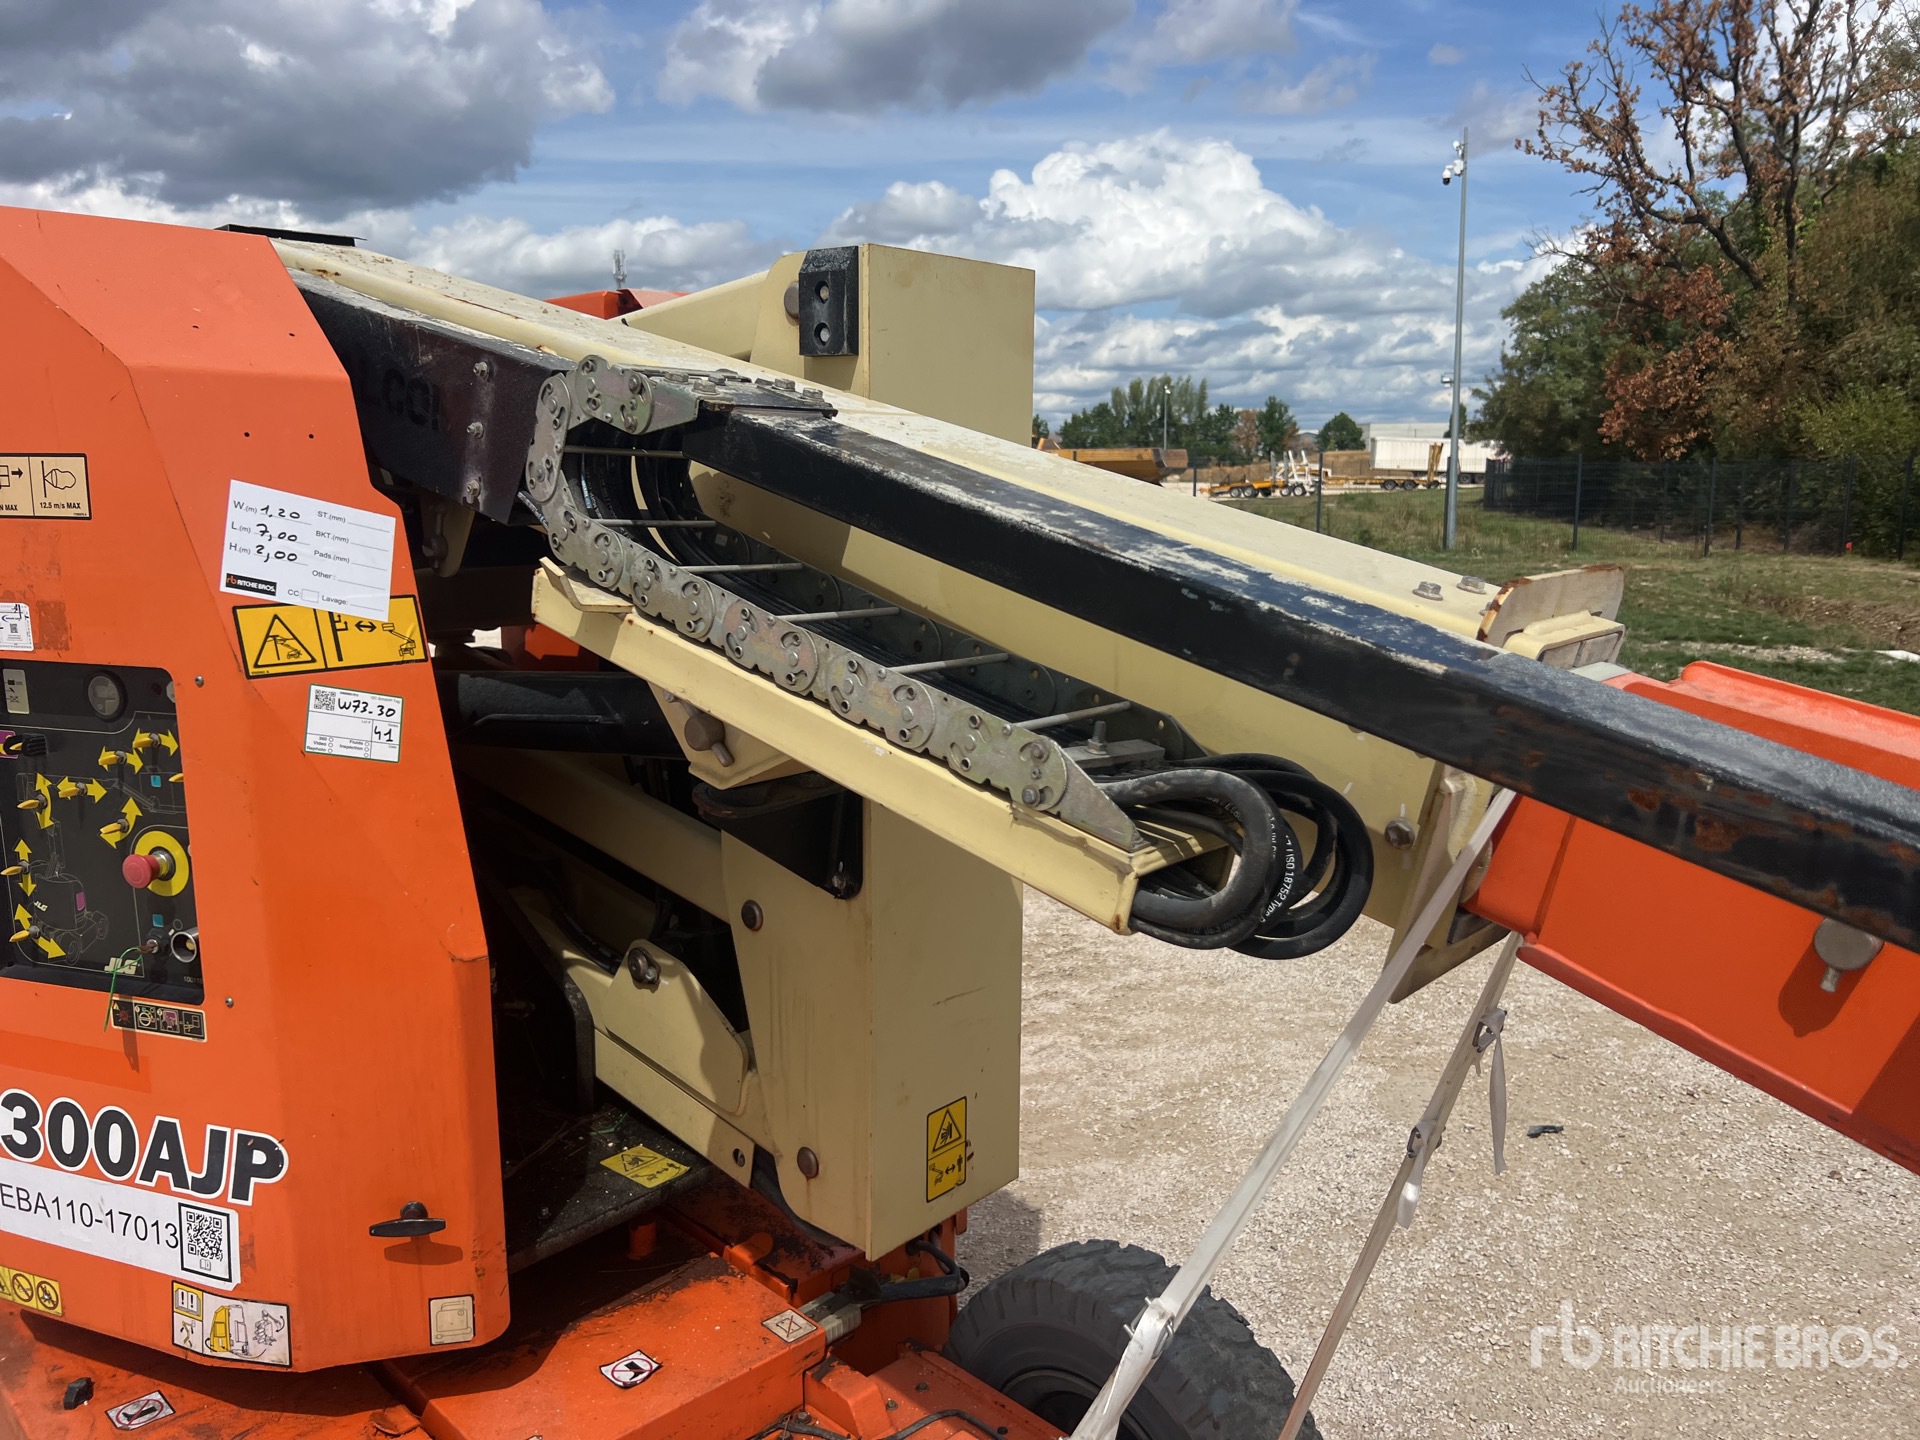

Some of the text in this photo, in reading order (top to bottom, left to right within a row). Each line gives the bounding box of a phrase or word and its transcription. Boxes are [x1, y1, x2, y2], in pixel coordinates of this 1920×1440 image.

[66, 502, 81, 510] MAX
[260, 504, 300, 520] 1,20
[256, 523, 298, 542] 7,00
[256, 544, 298, 562] 2,00
[312, 570, 332, 580] Other
[237, 579, 258, 590] RITCHIE
[374, 725, 394, 742] 41
[1276, 871, 1295, 900] 18752
[34, 900, 48, 912] JLG
[0, 1089, 288, 1206] 300AJP
[0, 1183, 180, 1249] EBA110-17013
